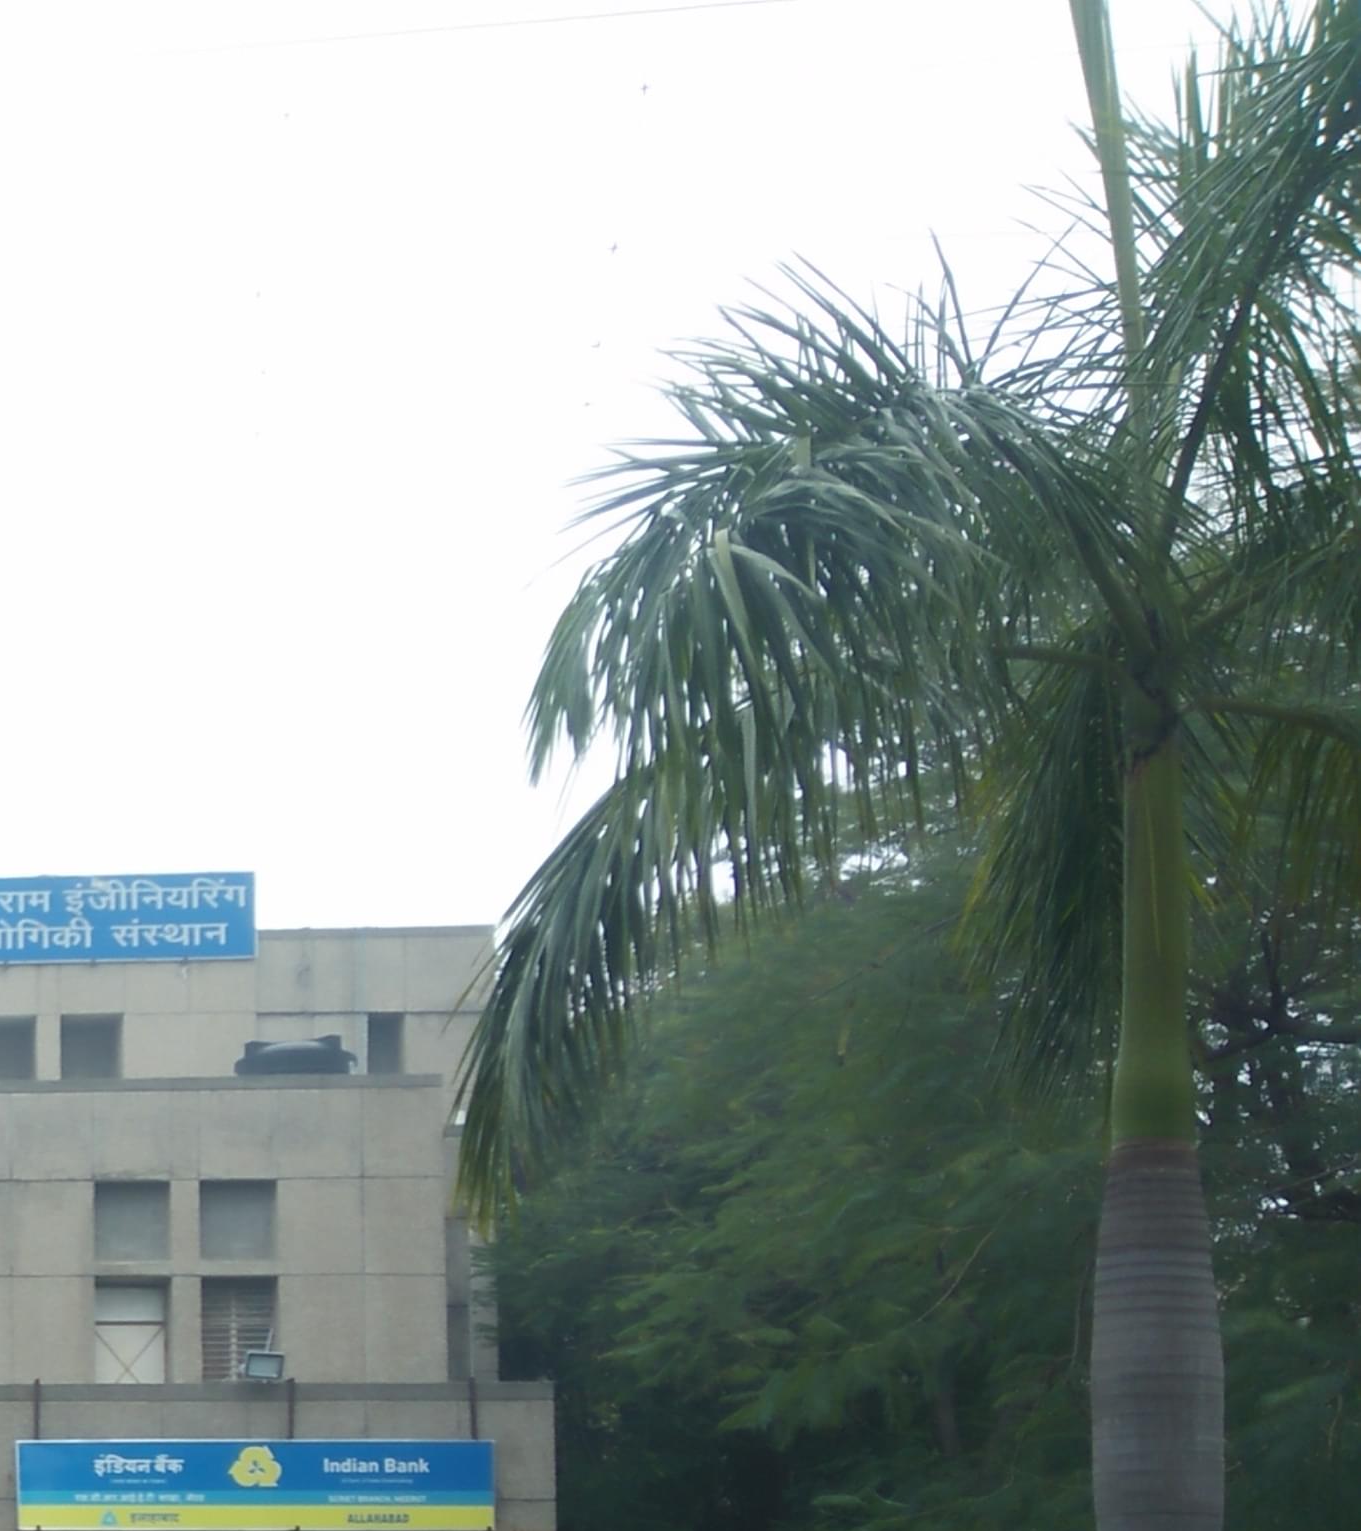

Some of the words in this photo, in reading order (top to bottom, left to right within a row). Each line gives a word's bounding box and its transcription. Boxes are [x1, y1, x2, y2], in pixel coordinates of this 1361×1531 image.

[110, 918, 229, 947] संस्थान
[93, 1453, 151, 1477] इंडियन
[152, 1454, 185, 1475] बैंक
[323, 1457, 379, 1473] Indian
[384, 1457, 430, 1473] Bank
